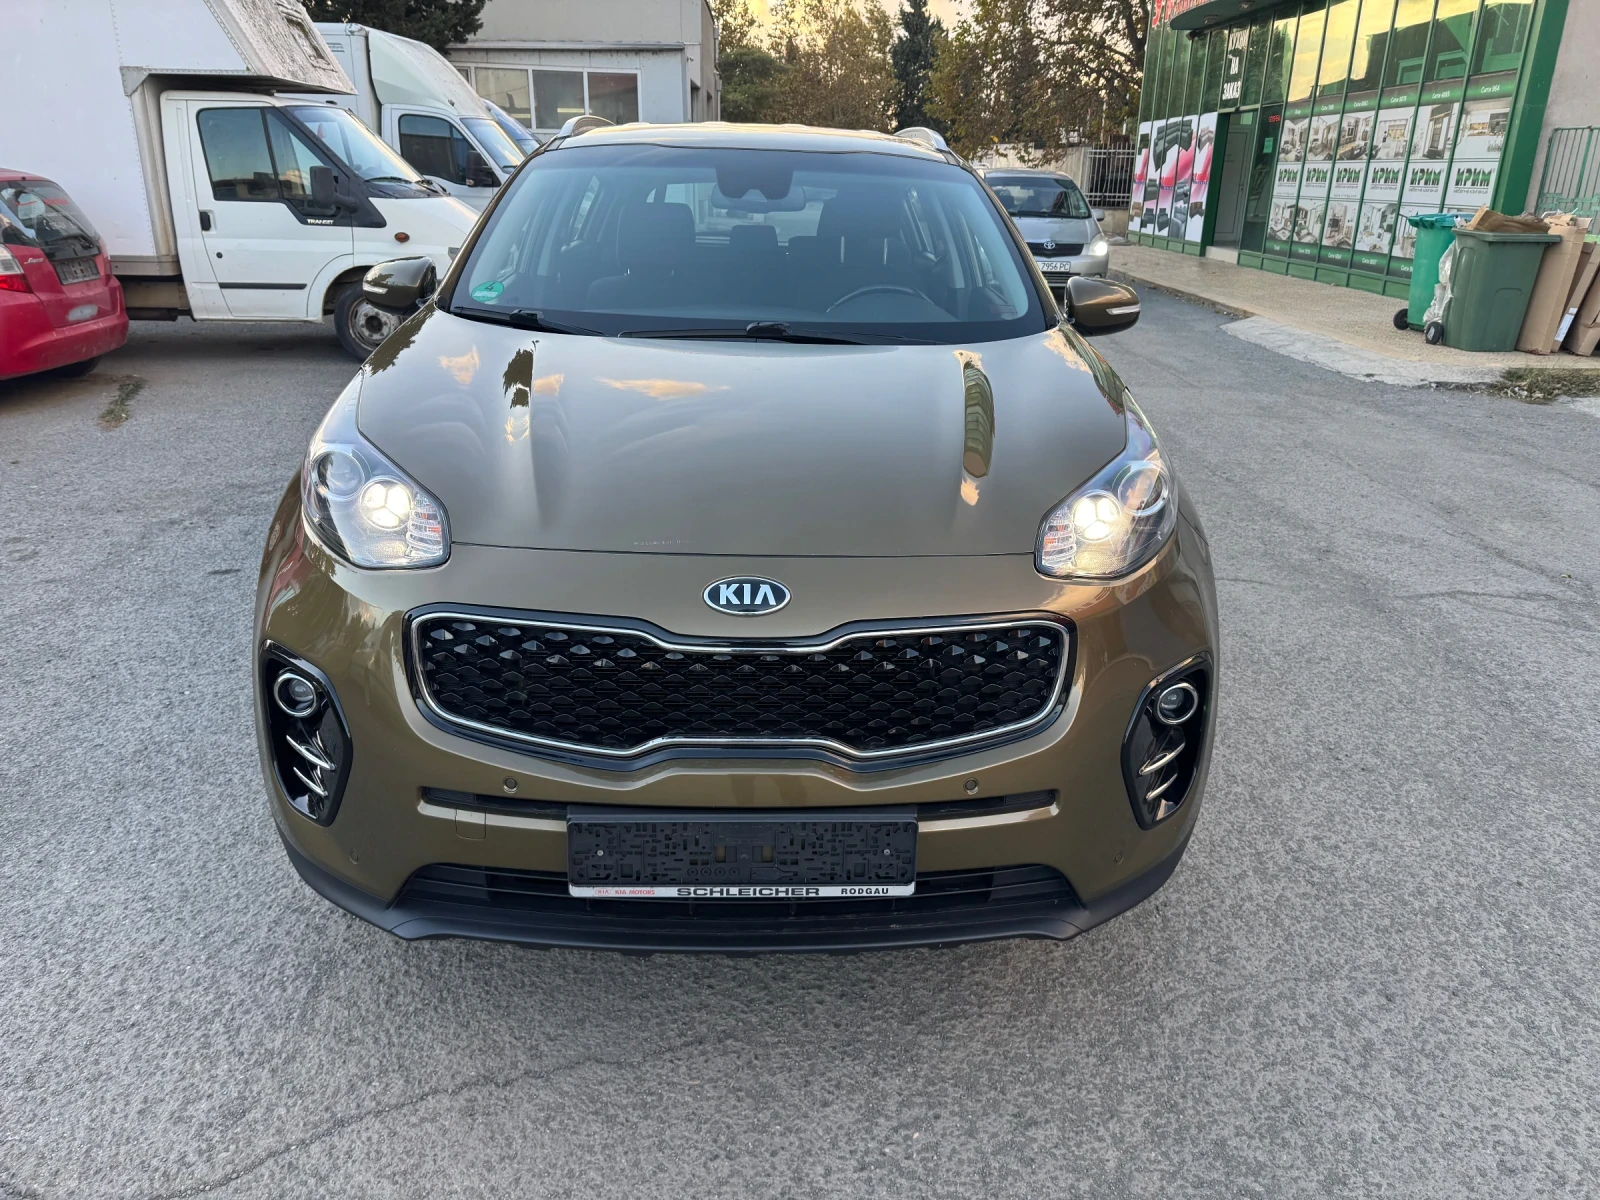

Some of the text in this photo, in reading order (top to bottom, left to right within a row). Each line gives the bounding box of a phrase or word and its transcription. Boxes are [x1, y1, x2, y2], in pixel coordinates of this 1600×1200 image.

[1222, 81, 1241, 100] ЗАКАЗ
[1278, 168, 1299, 183] ИРИМ
[1305, 167, 1329, 183] ИРИМ
[1335, 167, 1361, 183] ИРИМ
[1371, 167, 1400, 184] ИРИМ
[1410, 168, 1442, 186] ИРИМ
[1455, 168, 1492, 187] ИРИМ
[1041, 262, 1069, 271] 7956 PC
[485, 281, 495, 291] 4
[719, 583, 776, 605] KIA
[677, 887, 820, 896] SCHLEICHER
[841, 887, 889, 895] RODGAU
